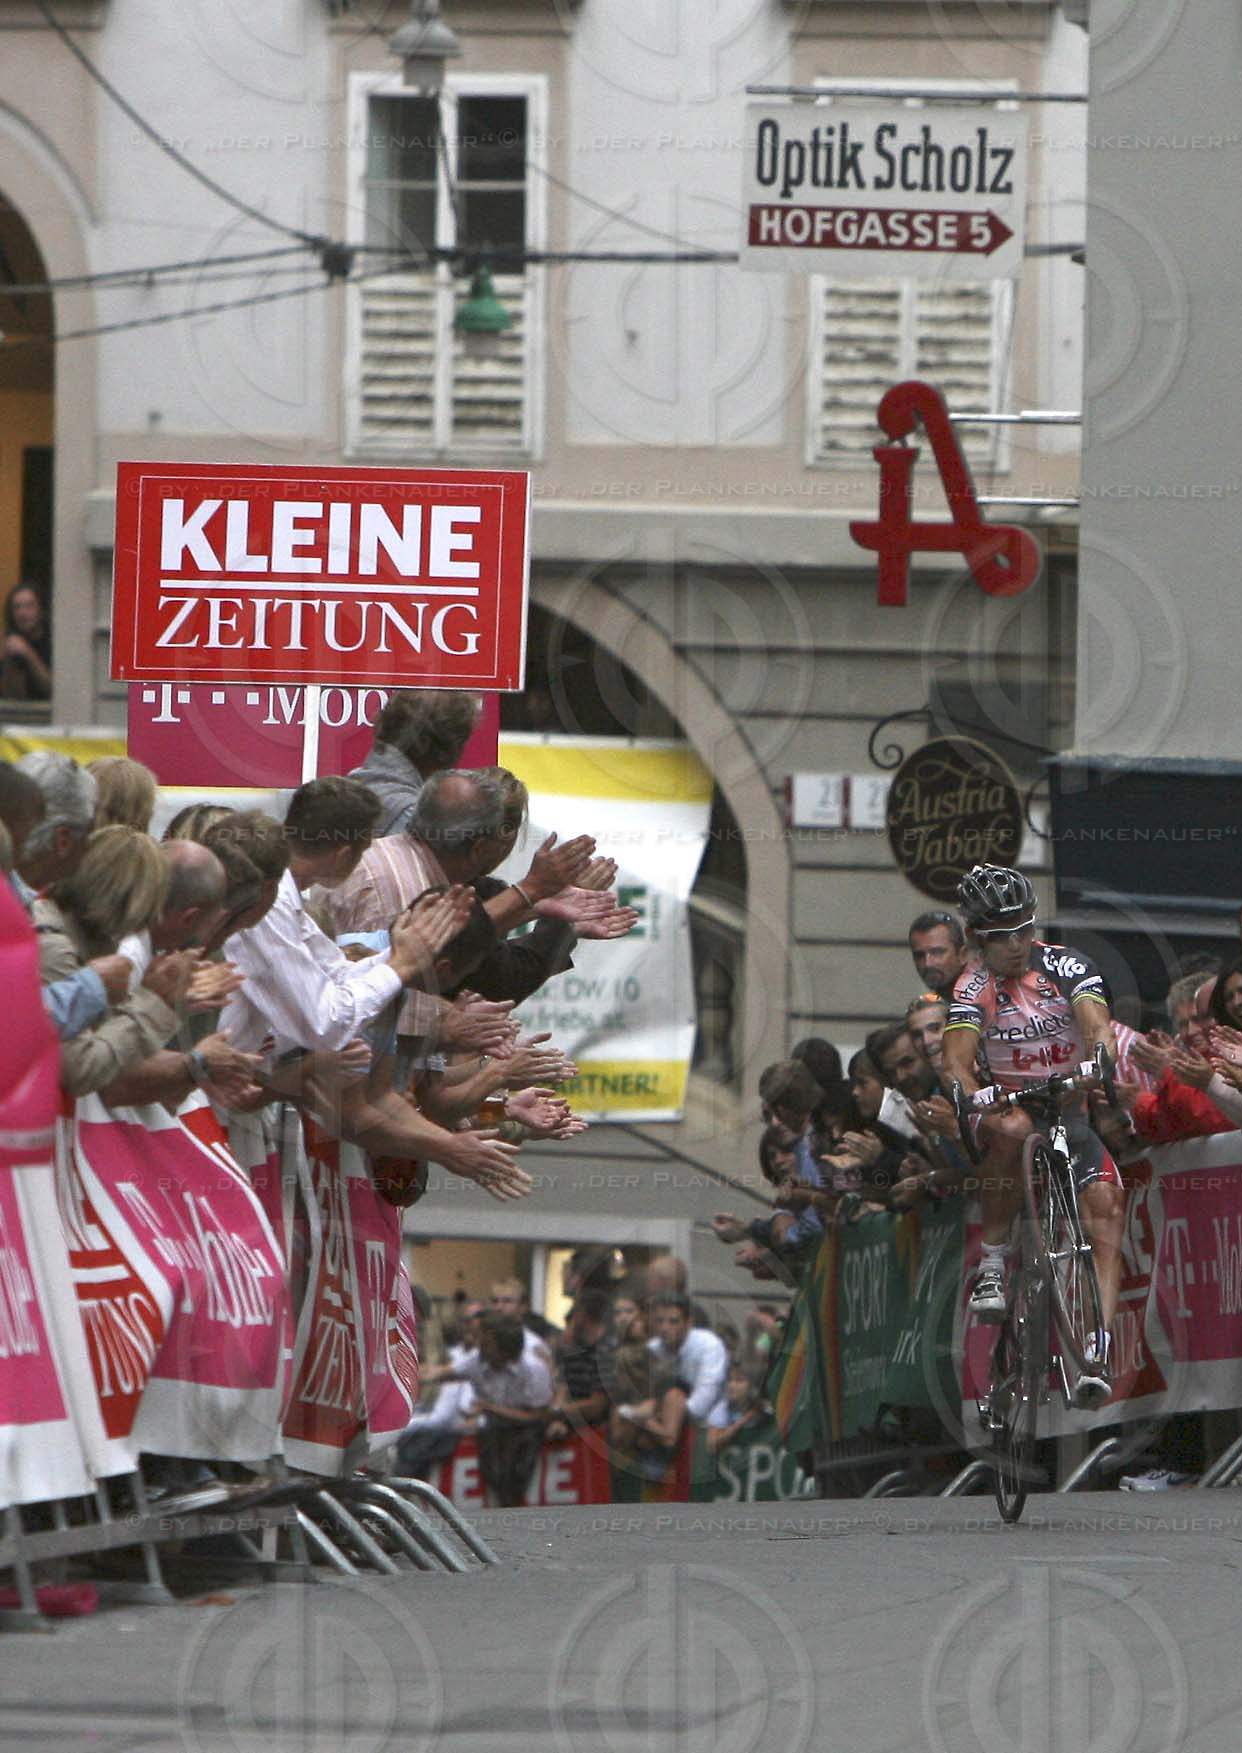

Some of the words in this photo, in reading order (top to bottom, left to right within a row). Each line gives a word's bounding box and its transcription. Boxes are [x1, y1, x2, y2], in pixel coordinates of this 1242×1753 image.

[756, 118, 865, 198] Optik
[874, 123, 1014, 194] Scholz
[759, 209, 958, 248] HOFGASSE
[970, 215, 992, 247] 5
[160, 498, 481, 578] KLEINE
[156, 595, 481, 656] ZEITUNG
[897, 775, 1006, 824] Austria
[902, 817, 1016, 870] Tabak
[717, 1444, 799, 1501] SPO
